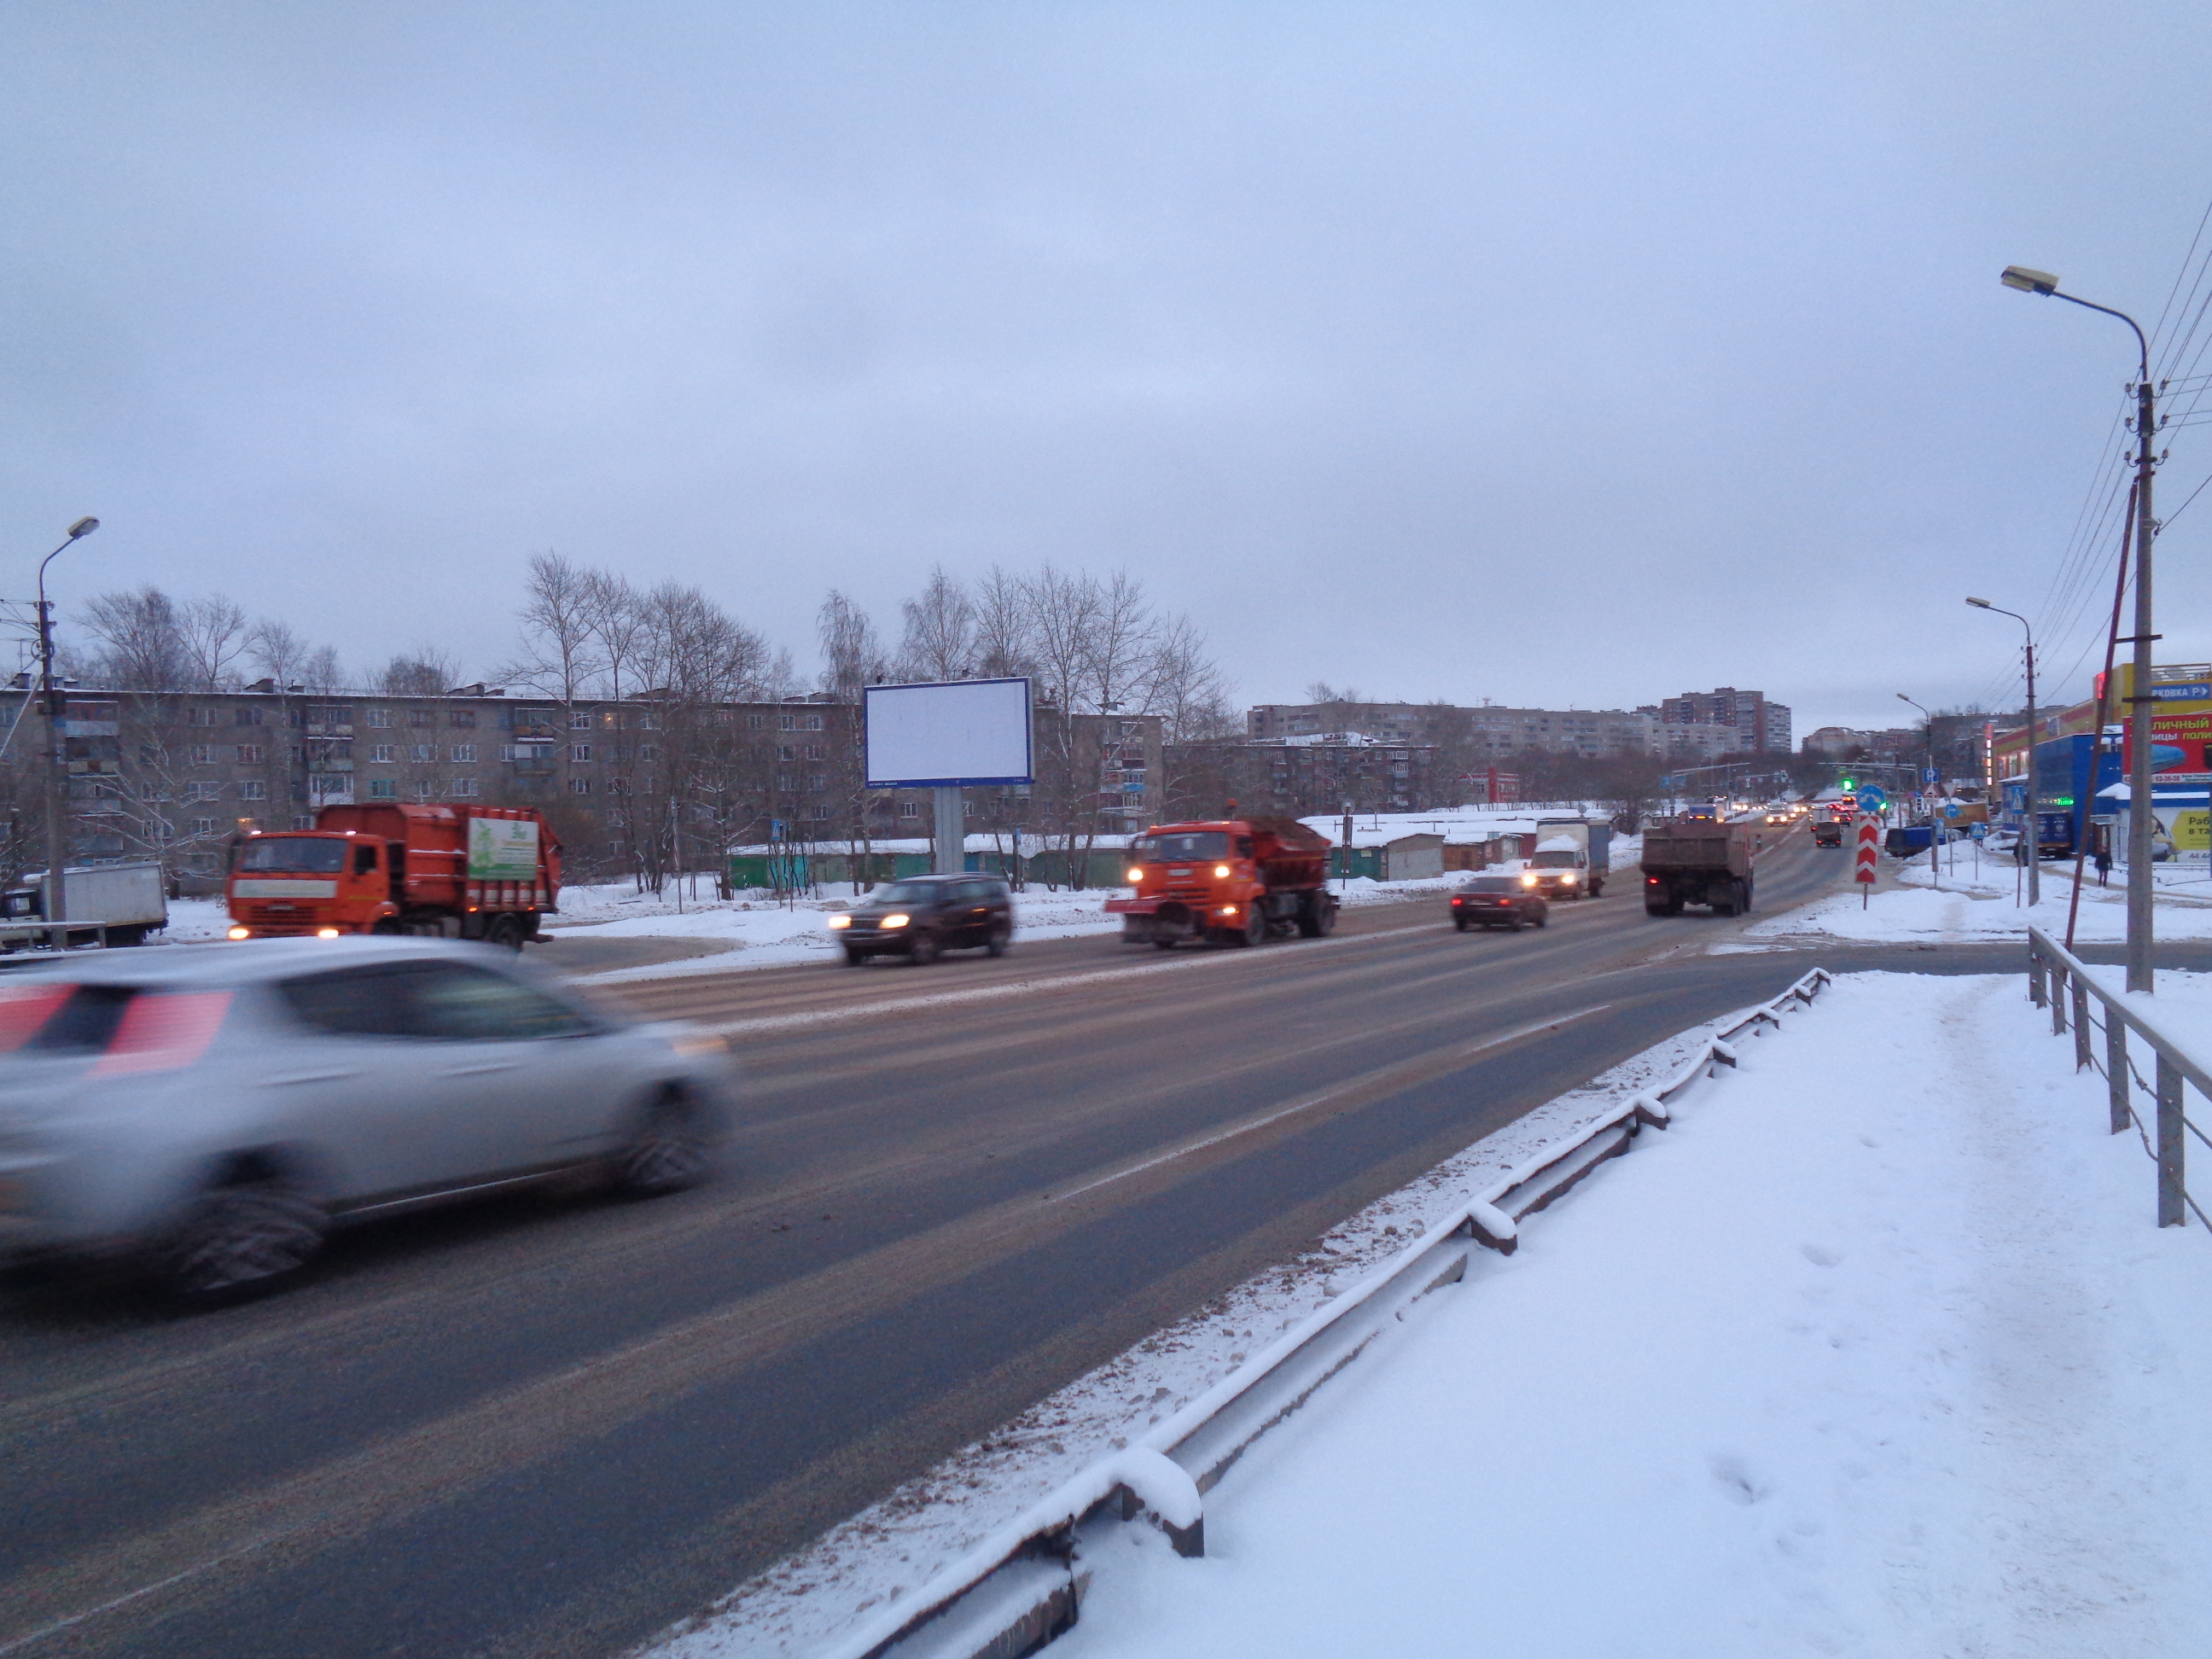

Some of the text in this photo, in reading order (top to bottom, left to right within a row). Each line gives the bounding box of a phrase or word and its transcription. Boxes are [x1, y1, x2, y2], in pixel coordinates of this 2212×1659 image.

[2151, 688, 2188, 697] РКОВКА
[2153, 717, 2209, 730] ЛИЧНЫЙ
[2182, 731, 2212, 740] ПОЛИ
[2189, 817, 2209, 825] Раб
